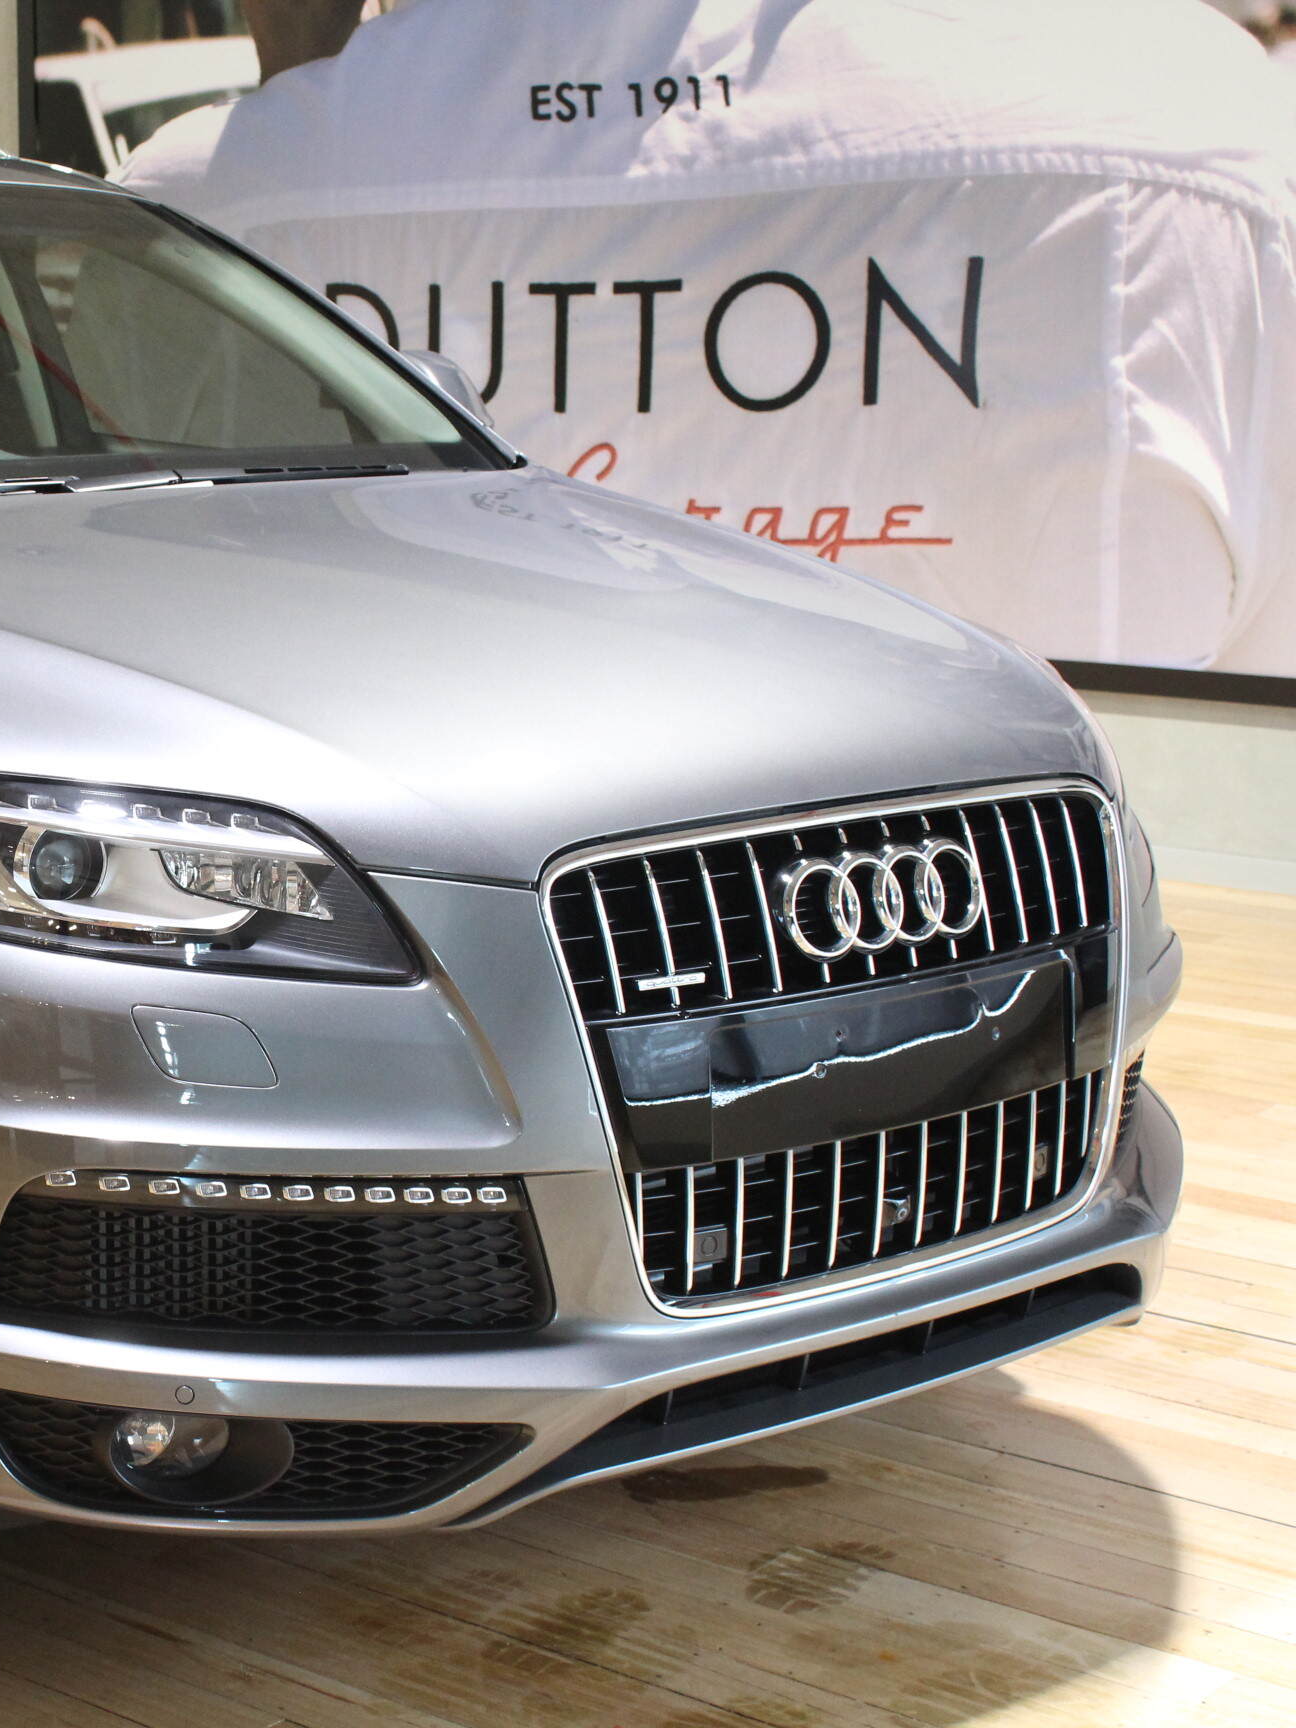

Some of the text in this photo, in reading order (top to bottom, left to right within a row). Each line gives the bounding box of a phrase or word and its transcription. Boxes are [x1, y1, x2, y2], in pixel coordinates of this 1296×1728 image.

[530, 73, 732, 122] EST 1911
[566, 441, 954, 563] rage
